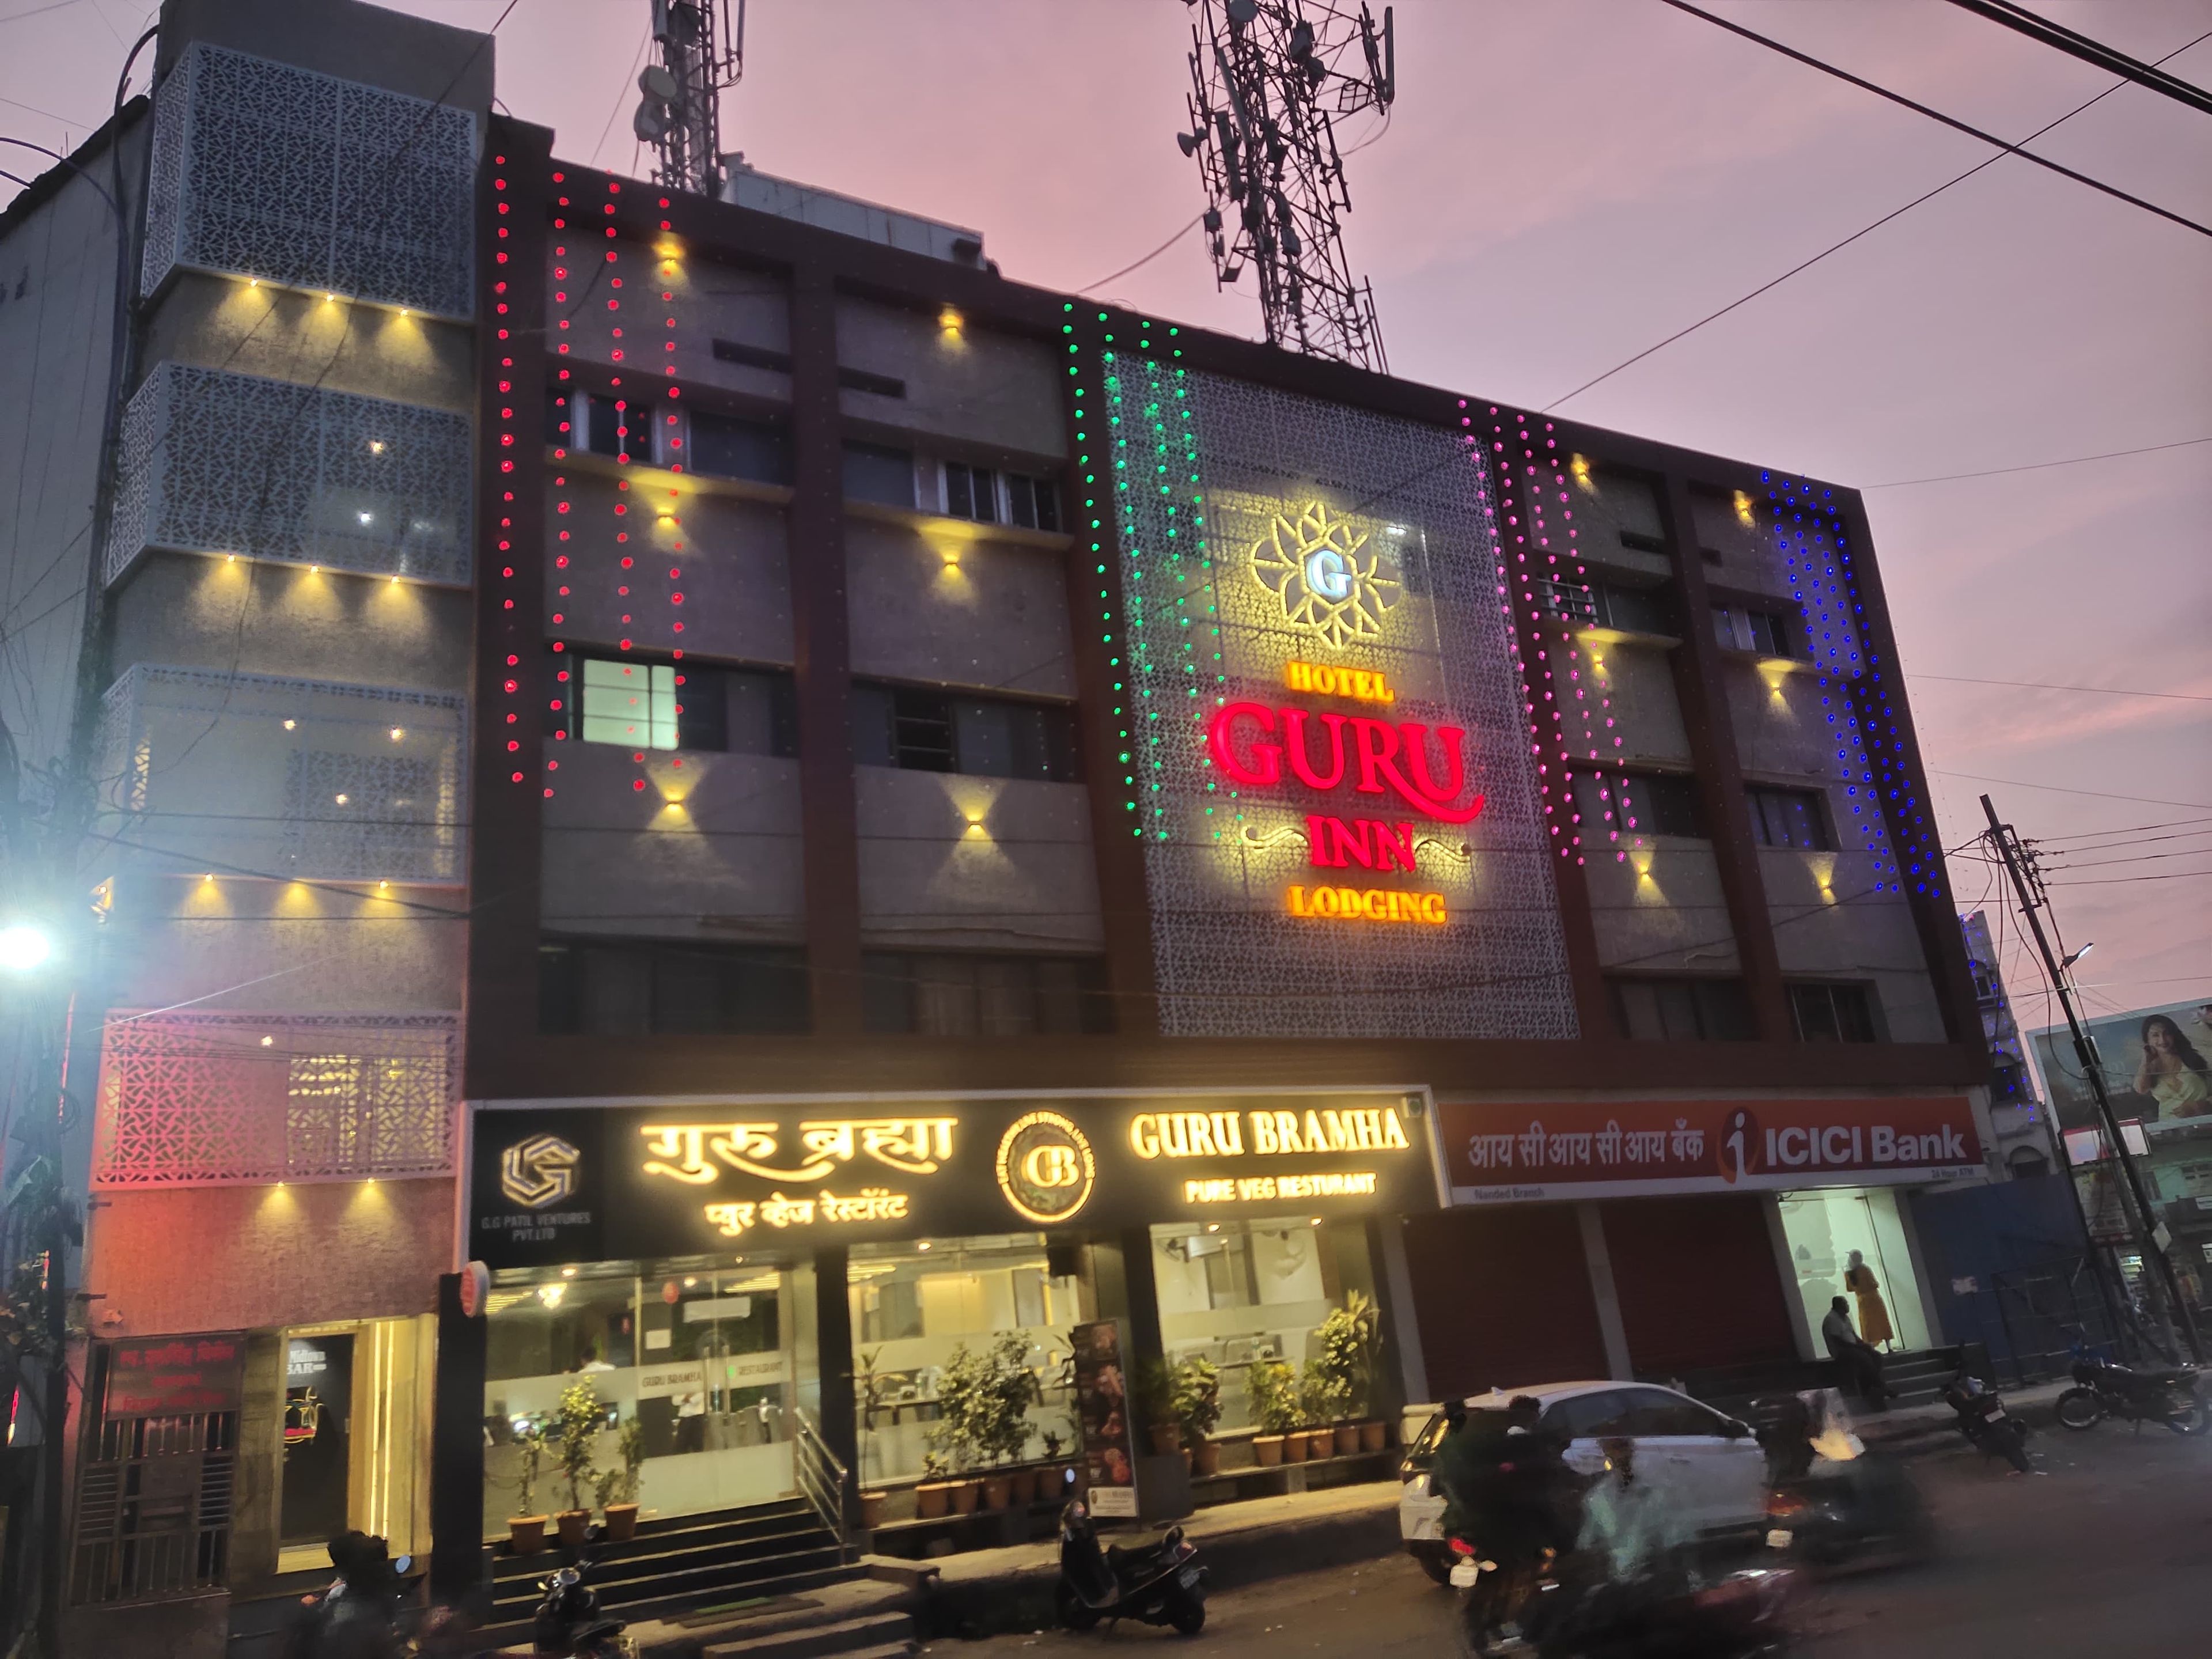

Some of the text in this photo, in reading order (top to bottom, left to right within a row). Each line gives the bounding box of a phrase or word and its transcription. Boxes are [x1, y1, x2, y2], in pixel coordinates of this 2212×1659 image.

[1305, 549, 1352, 599] G
[1287, 660, 1395, 703] HOTEL
[1210, 702, 1485, 823] GURU
[1306, 815, 1416, 873] INN
[1288, 885, 1448, 924] LODGING
[1130, 1106, 1410, 1160] GURU BRAMHA
[1468, 1134, 1515, 1168] आय
[1518, 1120, 1547, 1166] सी
[1548, 1132, 1592, 1166] आय
[1595, 1119, 1623, 1164] सी
[1624, 1131, 1666, 1163] आय
[1765, 1123, 1968, 1166] ICICI Bank
[1184, 1179, 1237, 1204] PURE
[1237, 1176, 1277, 1201] VEG
[1512, 1185, 1545, 1199] Branch
[1959, 1167, 1975, 1176] ATM
